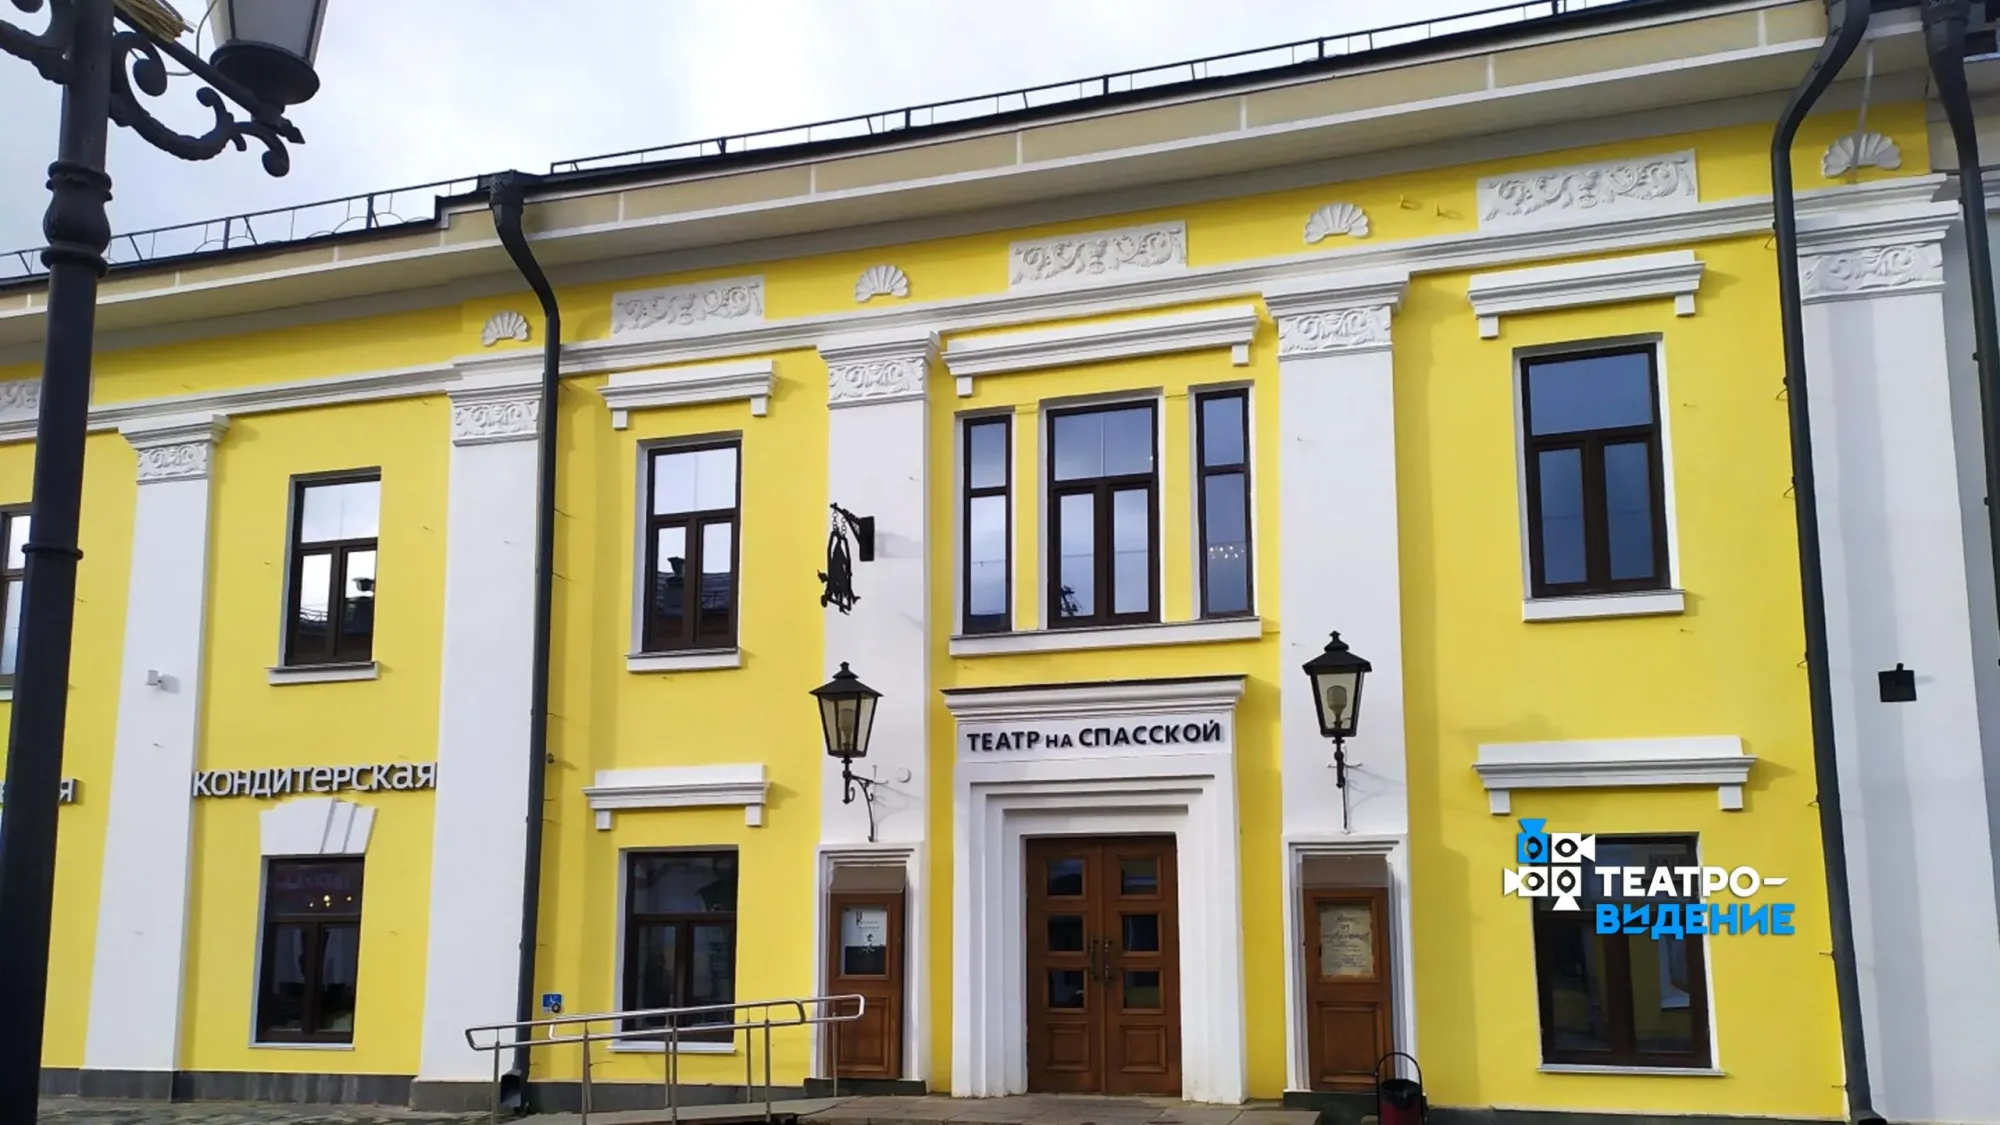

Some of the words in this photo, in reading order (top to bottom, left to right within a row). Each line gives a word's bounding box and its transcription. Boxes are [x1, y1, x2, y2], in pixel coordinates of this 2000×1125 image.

[967, 731, 1041, 752] ТЕАТР
[1046, 733, 1073, 748] НА
[1078, 719, 1221, 747] СПАССКОЙ
